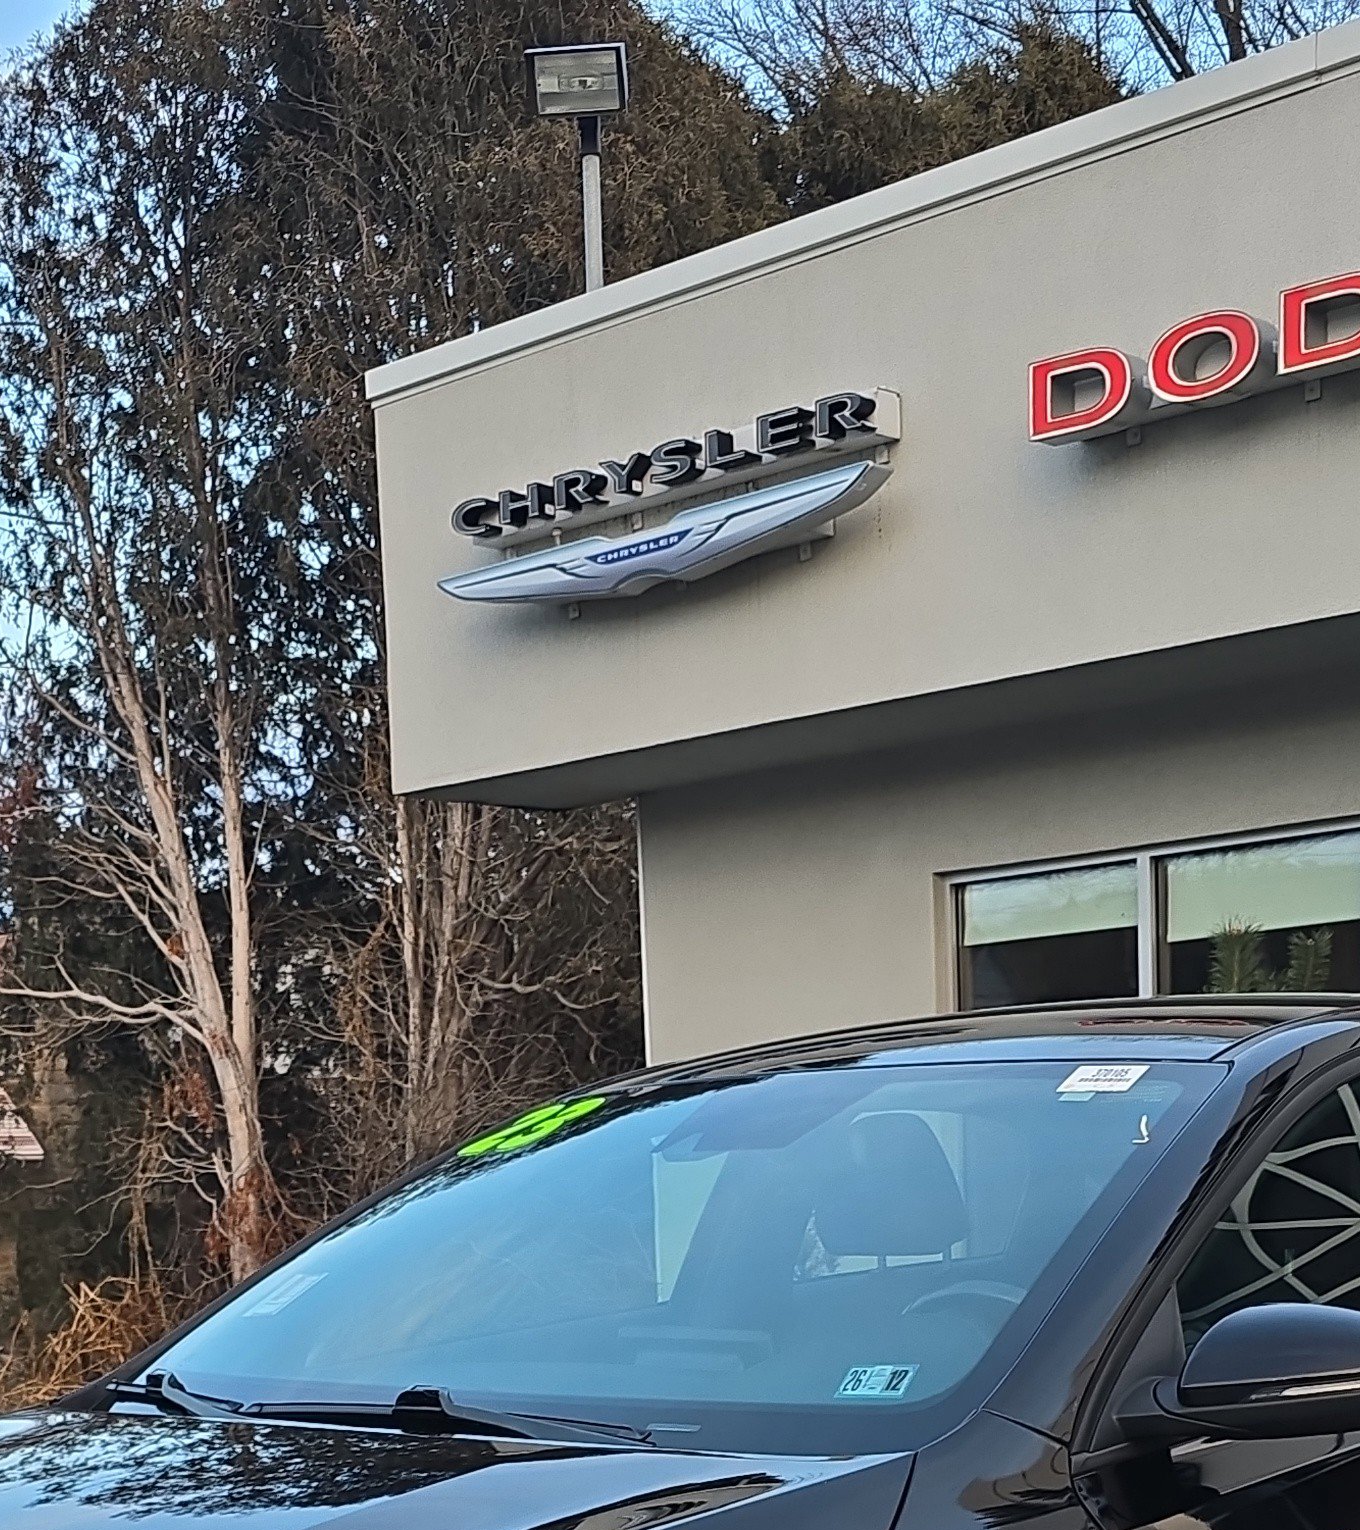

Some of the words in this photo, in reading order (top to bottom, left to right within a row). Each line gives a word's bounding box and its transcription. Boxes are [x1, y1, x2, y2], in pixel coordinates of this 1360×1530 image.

[451, 392, 877, 537] CHRYSLER
[596, 535, 680, 563] CHRYSLER
[884, 1369, 910, 1391] 12
